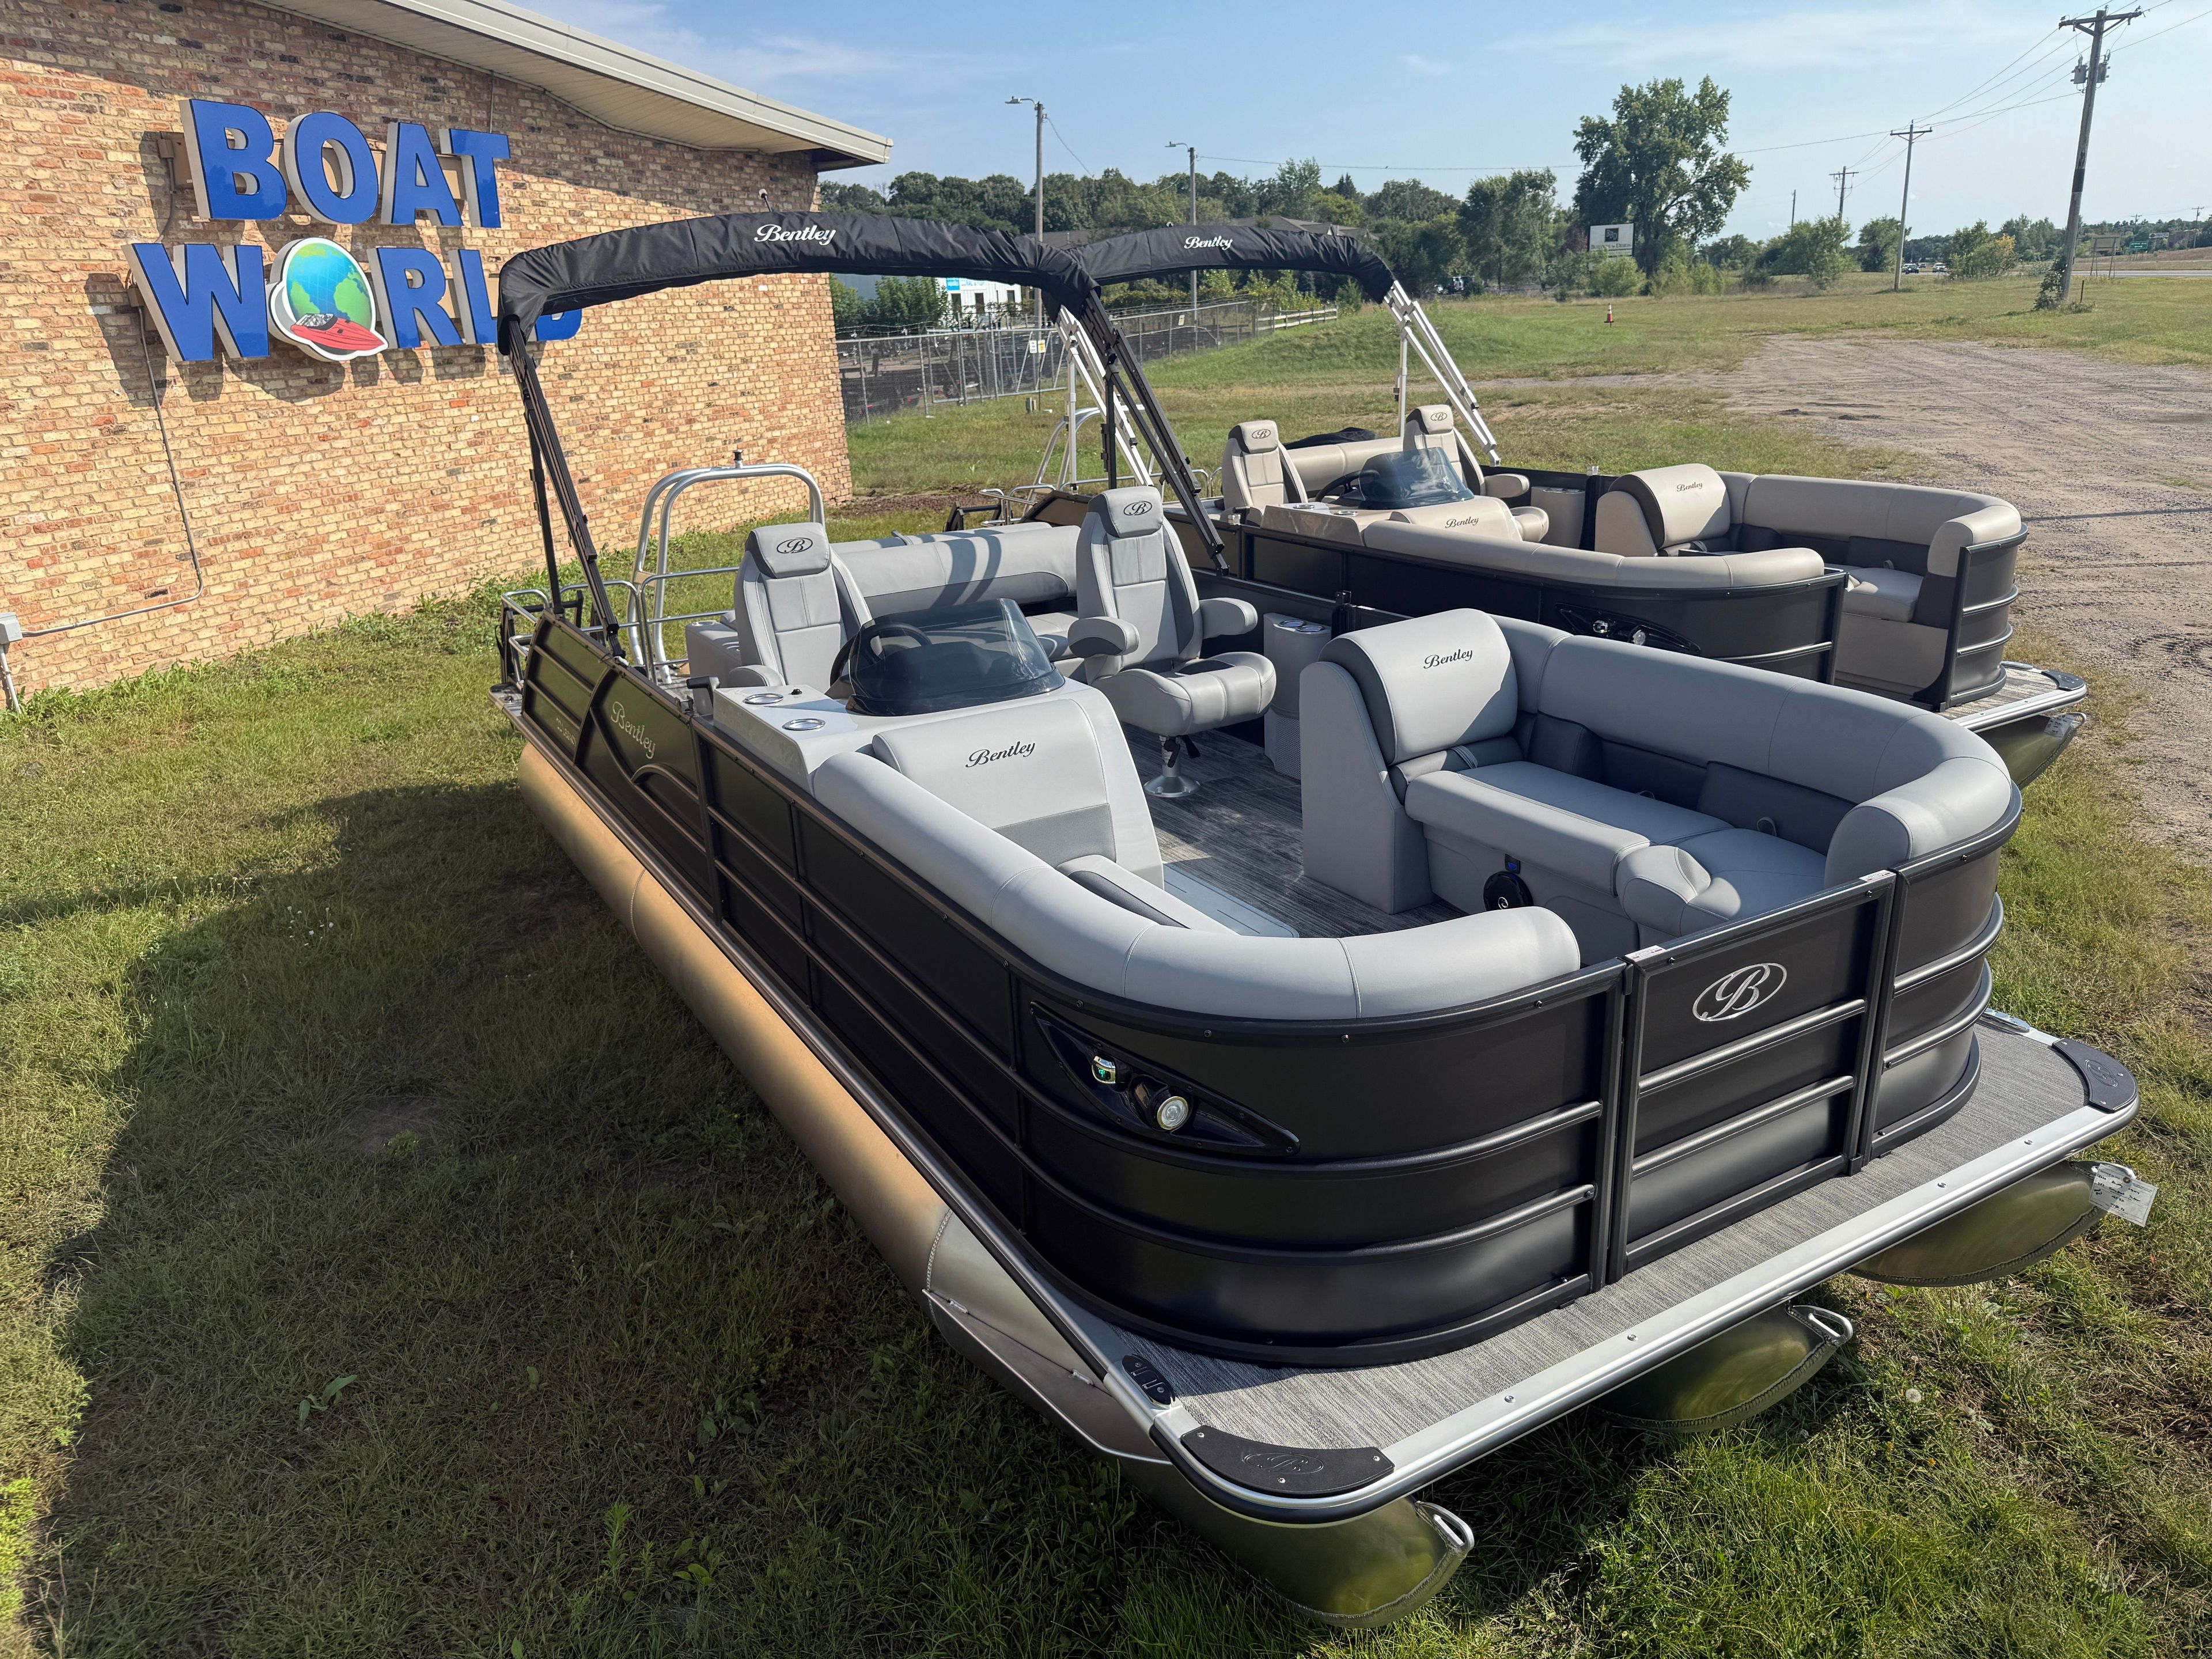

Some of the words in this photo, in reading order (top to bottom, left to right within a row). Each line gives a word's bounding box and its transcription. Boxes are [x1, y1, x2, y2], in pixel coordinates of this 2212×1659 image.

[180, 99, 510, 228] BOAT
[753, 224, 836, 245] Bentley
[1184, 236, 1232, 250] Bentley
[123, 237, 582, 361] WORL
[1676, 482, 1703, 491] Bentley
[1445, 516, 1479, 528] Bentley
[1423, 649, 1473, 669] Bentley
[611, 701, 656, 759] Bentley
[965, 741, 1035, 768] Bentley
[1700, 963, 1771, 1021] B
